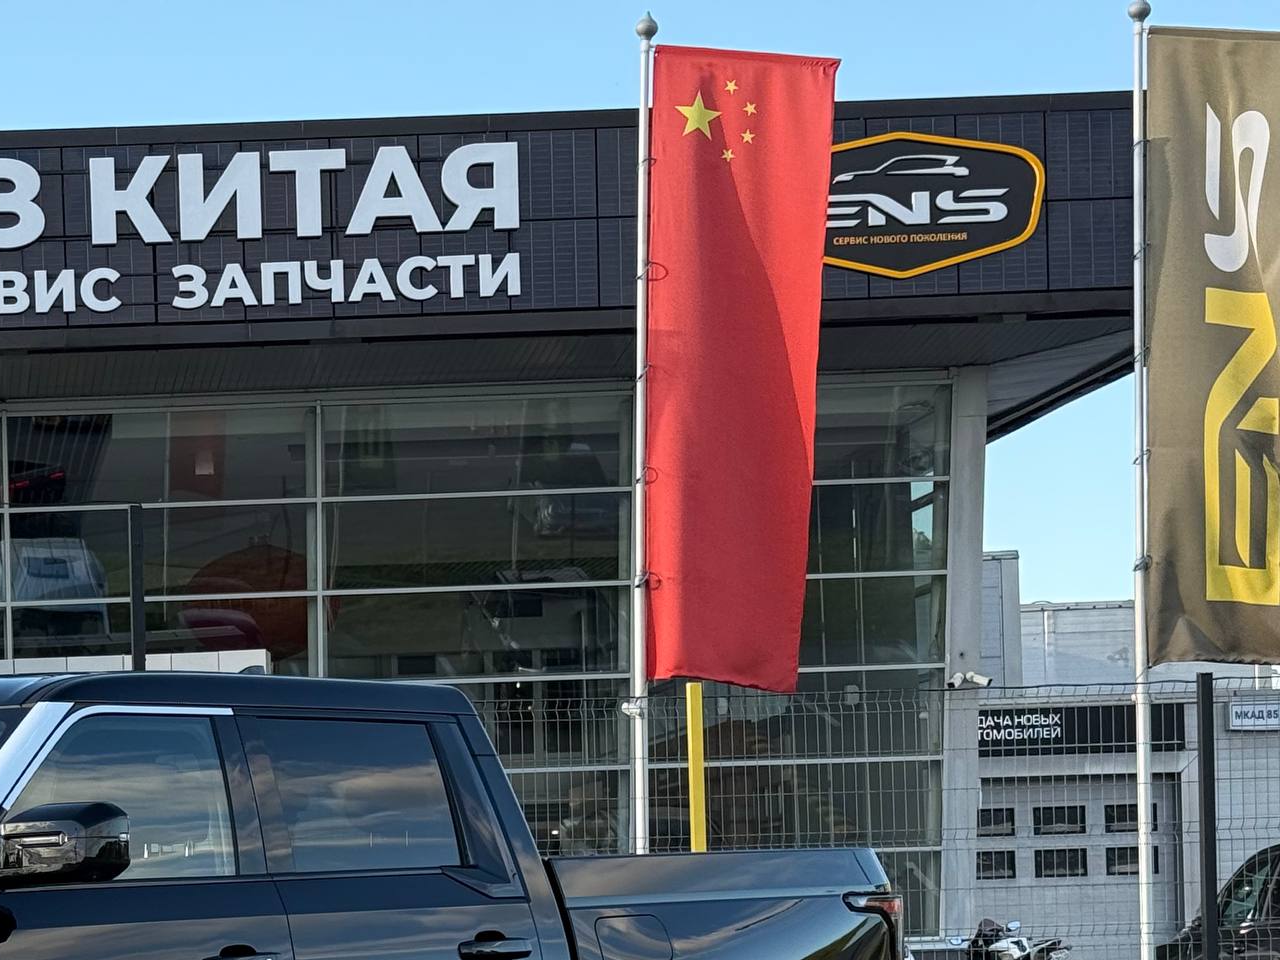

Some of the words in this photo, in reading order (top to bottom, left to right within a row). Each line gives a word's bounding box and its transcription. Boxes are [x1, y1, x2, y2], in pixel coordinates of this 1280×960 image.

[89, 141, 521, 246] КИТАЯ
[826, 188, 1010, 228] ENS
[833, 236, 869, 246] СЕРВИС
[870, 234, 908, 244] НОВОГО
[910, 232, 968, 243] ПОКОЛЕНИЯ
[171, 252, 521, 311] ЗАПЧАСТИ
[977, 715, 1013, 728] ДАЧА
[1014, 713, 1061, 726] НОВЫХ
[1235, 710, 1265, 720] МКАД
[977, 726, 1062, 740] ТОМОБИЛЕЙ
